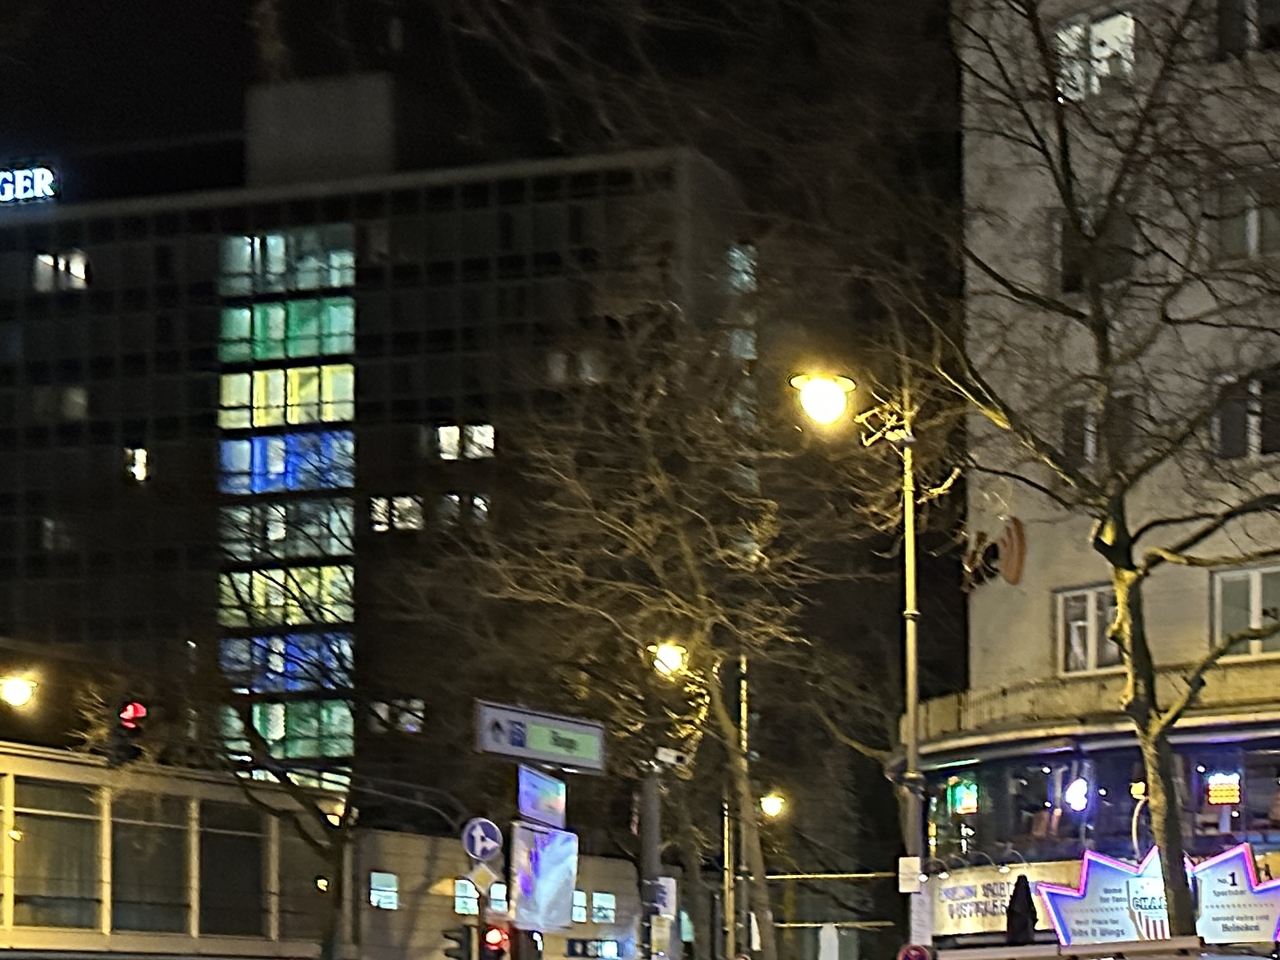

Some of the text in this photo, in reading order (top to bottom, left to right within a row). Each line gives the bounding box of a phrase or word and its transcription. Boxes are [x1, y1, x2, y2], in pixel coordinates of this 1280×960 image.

[0, 168, 55, 201] GER
[1213, 889, 1247, 897] Sportsbar
[1222, 923, 1260, 932] Heineken
